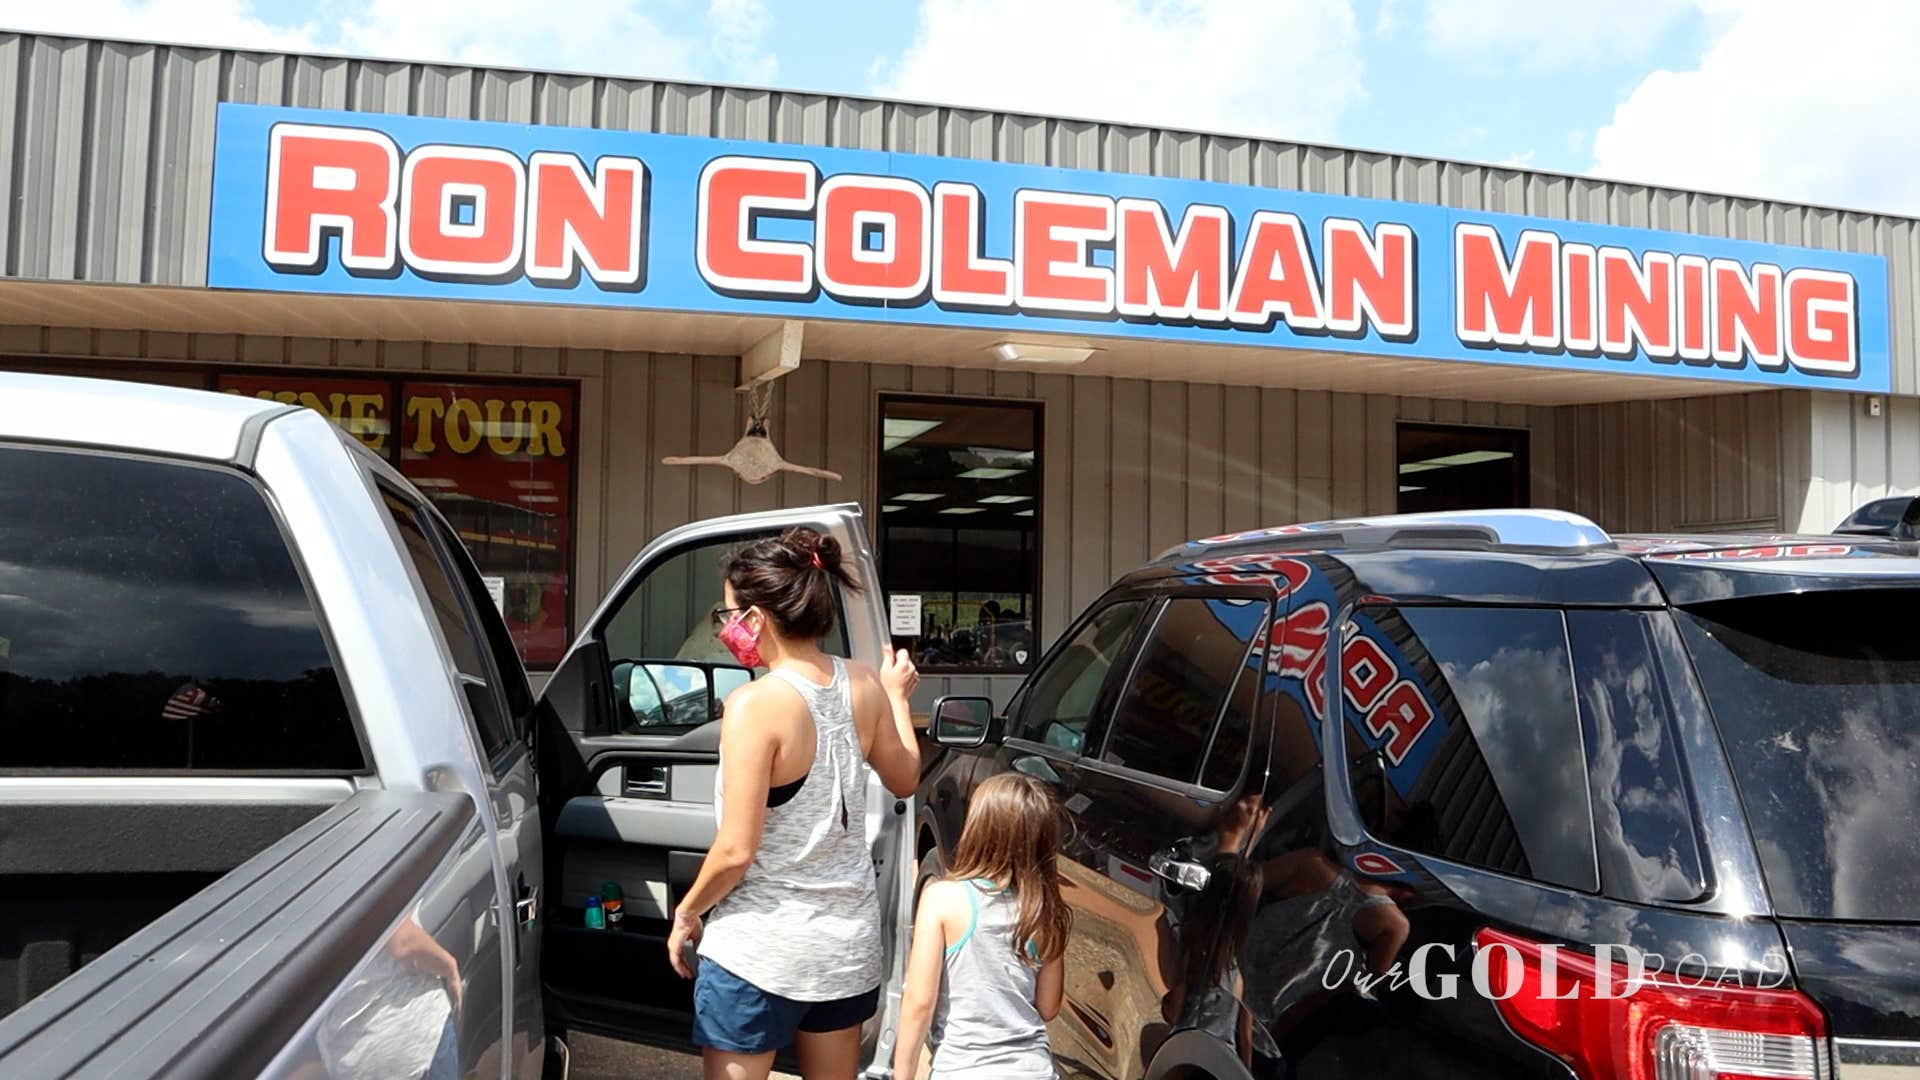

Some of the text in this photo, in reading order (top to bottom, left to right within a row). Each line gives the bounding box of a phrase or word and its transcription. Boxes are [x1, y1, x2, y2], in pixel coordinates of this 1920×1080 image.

[263, 123, 1860, 375] RON COLEMAN MINING
[407, 396, 566, 456] TOUR
